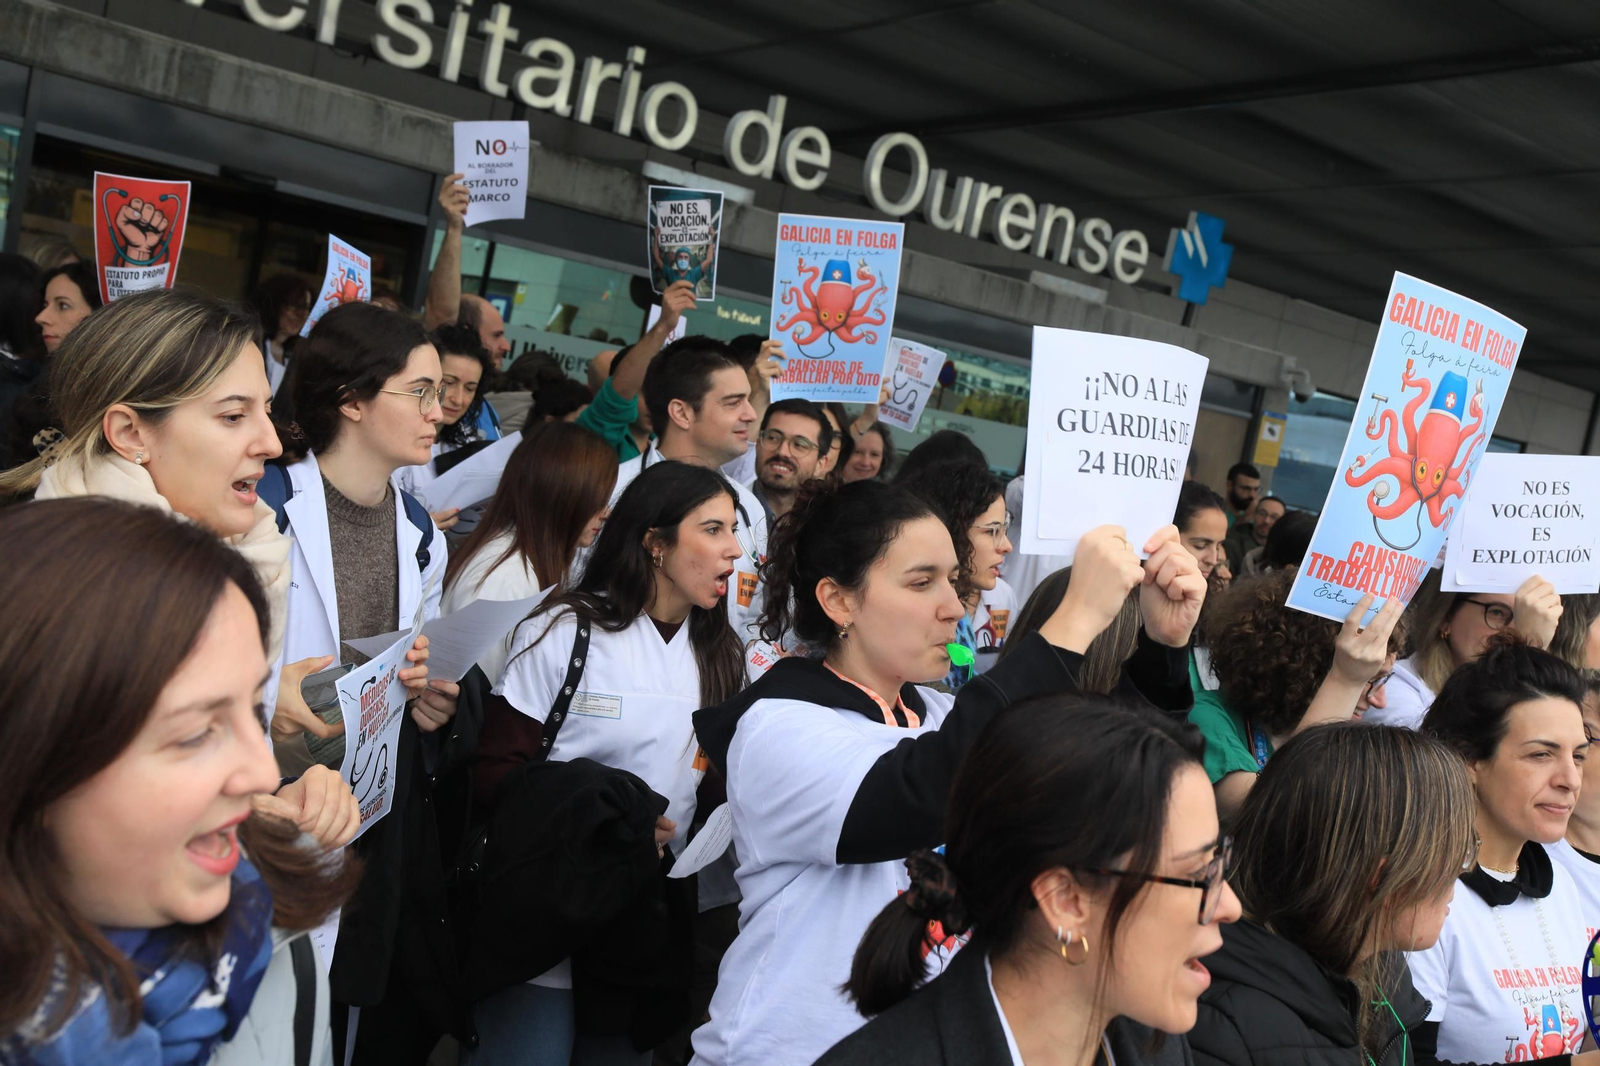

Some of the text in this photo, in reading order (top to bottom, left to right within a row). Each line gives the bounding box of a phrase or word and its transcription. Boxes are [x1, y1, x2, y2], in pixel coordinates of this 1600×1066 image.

[475, 139, 507, 156] NO
[468, 193, 511, 203] MARCO
[723, 95, 831, 191] de
[863, 131, 1149, 285] Ourense
[670, 203, 684, 215] NO
[660, 230, 710, 243] EXPLOTACIÓN
[780, 224, 897, 250] GALICIA EN FOLGA
[106, 266, 166, 280] ESTATUTO PROPIO
[107, 279, 124, 288] PARA
[109, 288, 116, 297] EL
[1389, 292, 1518, 371] GALICIA EN FOLGA
[1401, 331, 1451, 368] Folga
[786, 359, 864, 375] CANSADOS DE
[831, 370, 854, 385] POR
[1144, 377, 1158, 402] A
[1162, 379, 1188, 407] LAS
[1057, 408, 1190, 446] GUARDIAS DE
[1078, 449, 1106, 475] 24
[1522, 481, 1571, 496] NO ES
[1491, 500, 1584, 520] VOCACIÓN,
[1531, 527, 1551, 541] ES
[1471, 545, 1592, 565] EXPLOTACIÓN
[360, 671, 390, 713] MÉDICOS
